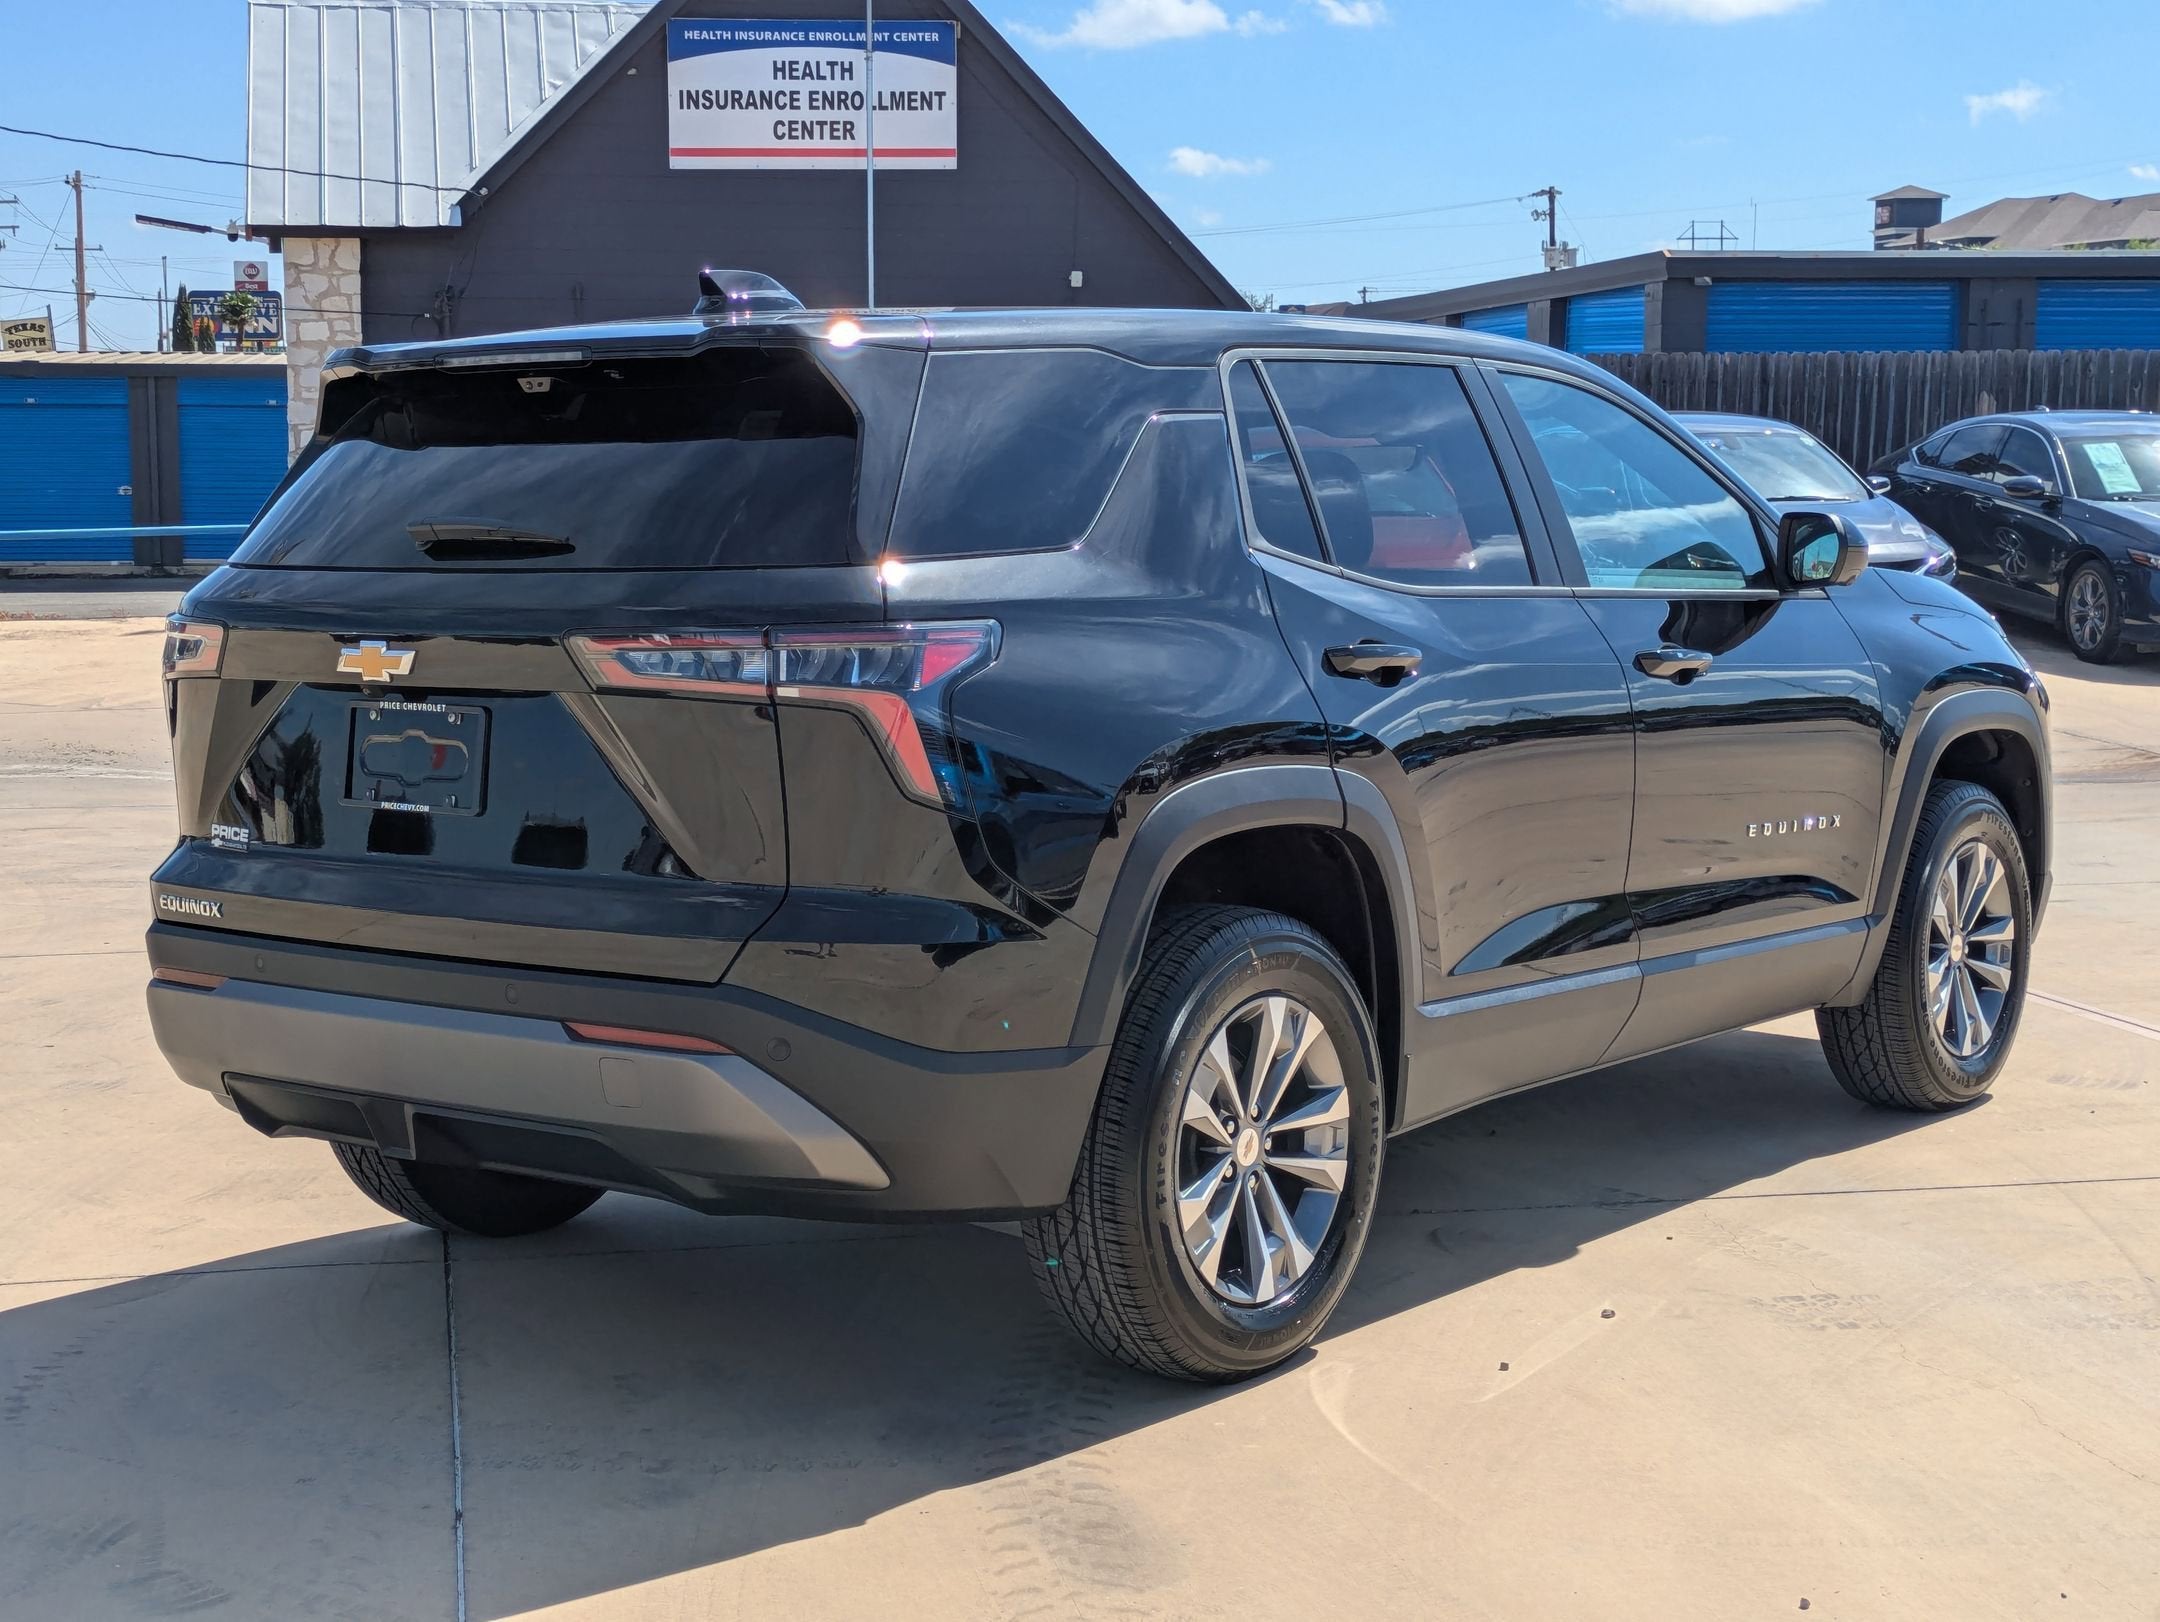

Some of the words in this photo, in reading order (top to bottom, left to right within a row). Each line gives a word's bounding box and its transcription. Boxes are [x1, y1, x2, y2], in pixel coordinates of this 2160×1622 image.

[684, 30, 731, 41] HEALTH
[735, 30, 805, 42] INSURANCE
[809, 31, 890, 42] ENROLLMNT
[893, 32, 940, 42] CENTER
[772, 60, 854, 81] HEALTH
[679, 89, 801, 111] INSURANCE
[773, 120, 856, 141] CENTER
[4, 322, 46, 335] TEXAS
[8, 337, 47, 349] SOUTH
[380, 701, 401, 710] PRICE
[403, 702, 447, 713] CHEVROLET
[211, 823, 249, 843] PRICE
[1747, 814, 1841, 837] EQUINOX
[160, 894, 223, 919] EQUINOX
